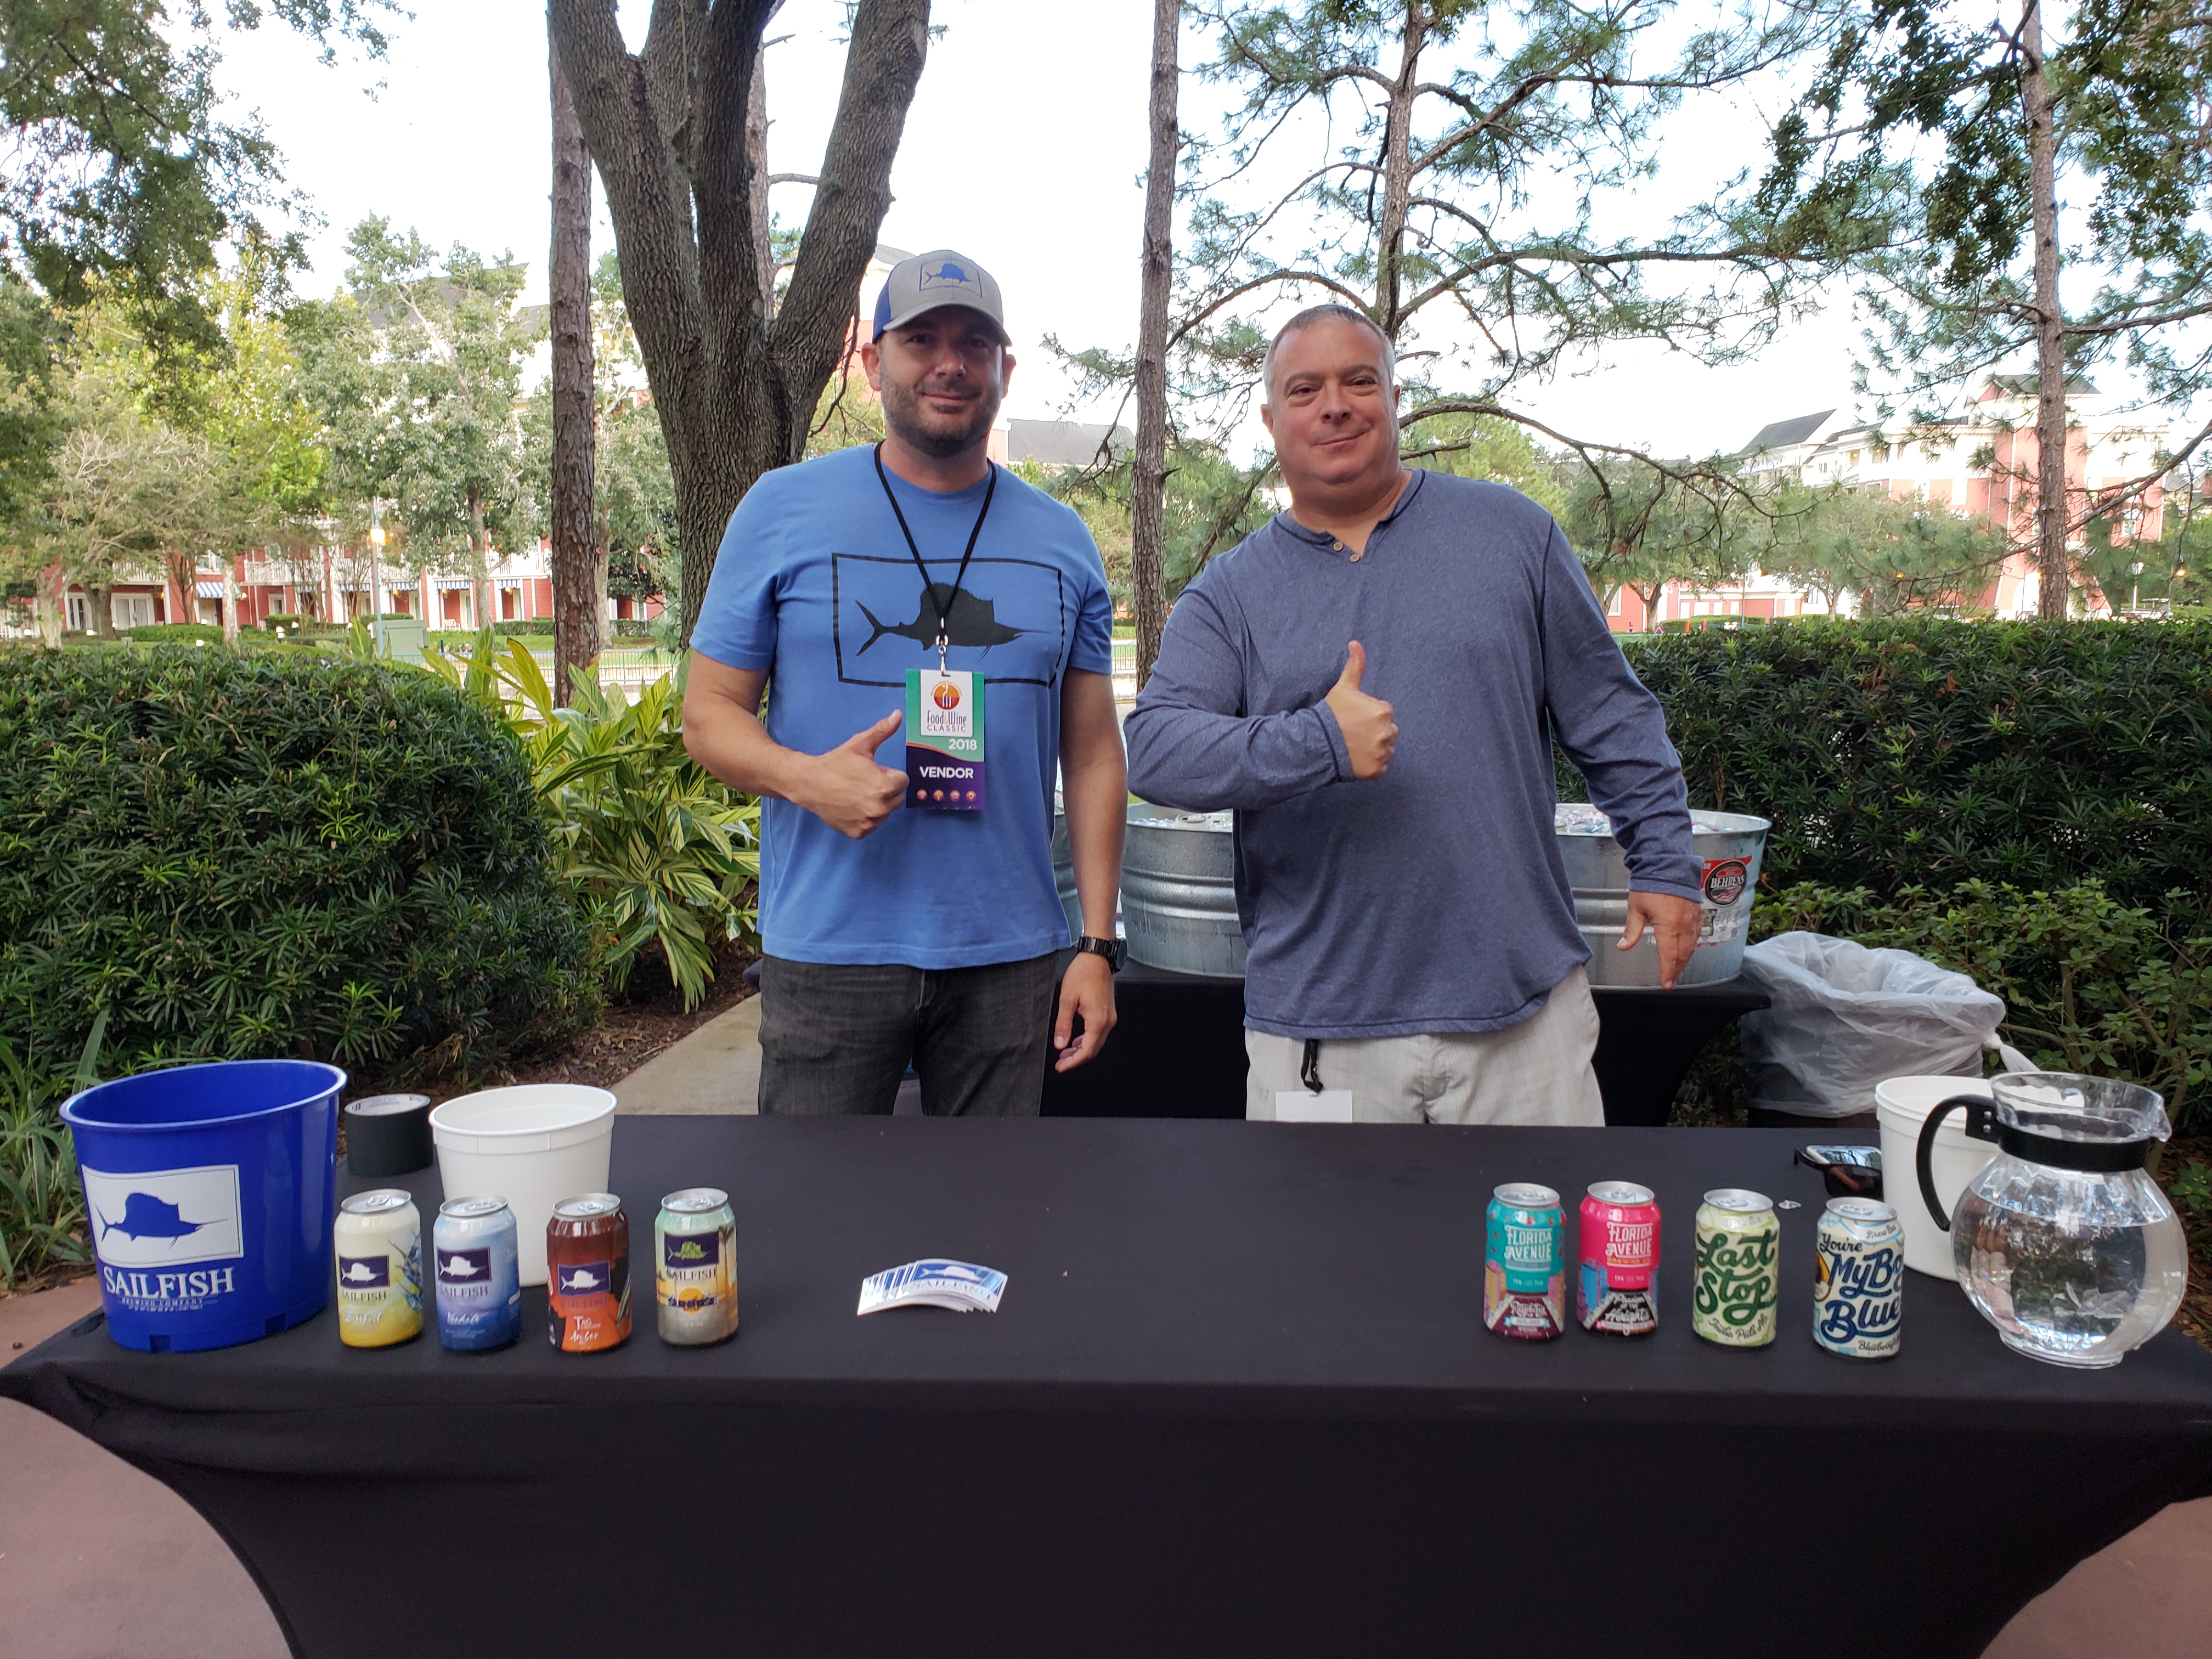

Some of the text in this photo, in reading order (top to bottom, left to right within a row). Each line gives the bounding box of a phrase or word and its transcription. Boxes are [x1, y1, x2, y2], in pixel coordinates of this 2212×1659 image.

[927, 710, 944, 724] Food
[948, 710, 967, 727] Wine
[927, 724, 966, 732] CLASSIC
[948, 738, 978, 751] 2018
[919, 766, 974, 779] VENDOR
[1710, 875, 1745, 889] BEHRENS
[1504, 1224, 1553, 1245] FLORIDA
[1607, 1222, 1653, 1242] FLORIDA
[1504, 1243, 1551, 1262] AVENUE
[1605, 1238, 1651, 1258] AVENUE
[1819, 1233, 1863, 1255] You're
[1696, 1229, 1778, 1281] Last
[104, 1266, 236, 1299] SAILFISH
[666, 1266, 716, 1281] SAILFISH
[159, 1297, 203, 1307] COMPANY
[1696, 1268, 1777, 1326] Stop
[1821, 1299, 1901, 1344] Blue
